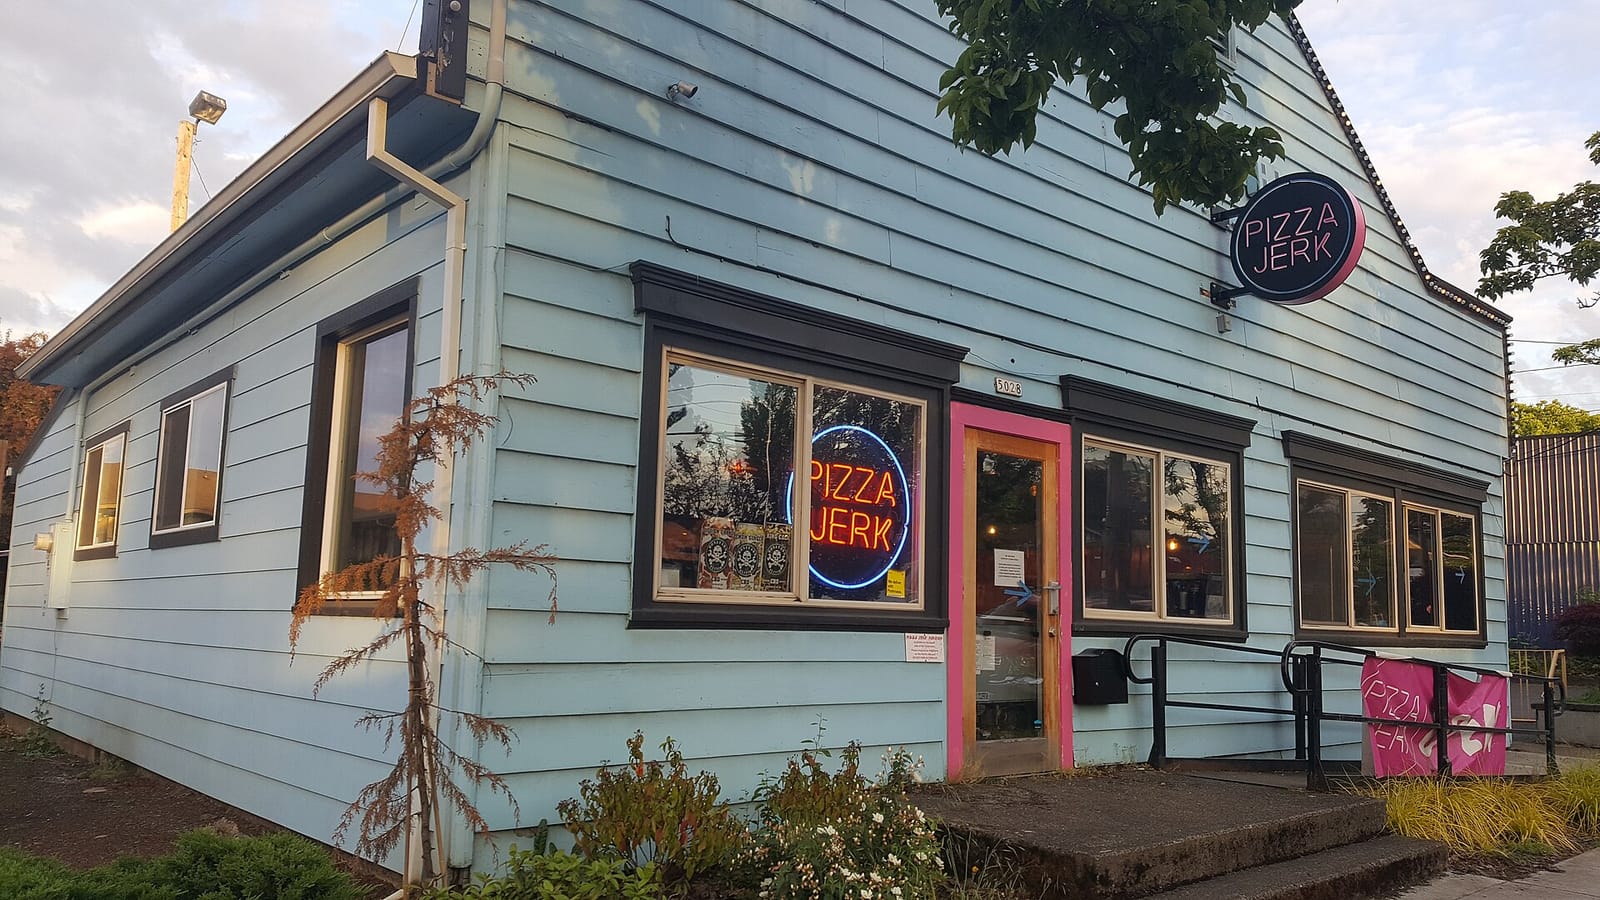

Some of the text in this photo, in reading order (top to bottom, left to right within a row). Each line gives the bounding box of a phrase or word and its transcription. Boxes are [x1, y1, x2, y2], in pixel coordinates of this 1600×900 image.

[1245, 202, 1339, 248] PIZZA
[1253, 232, 1333, 274] JERK
[997, 379, 1022, 394] 5028
[810, 459, 896, 508] PIZZA
[810, 506, 893, 552] JERK
